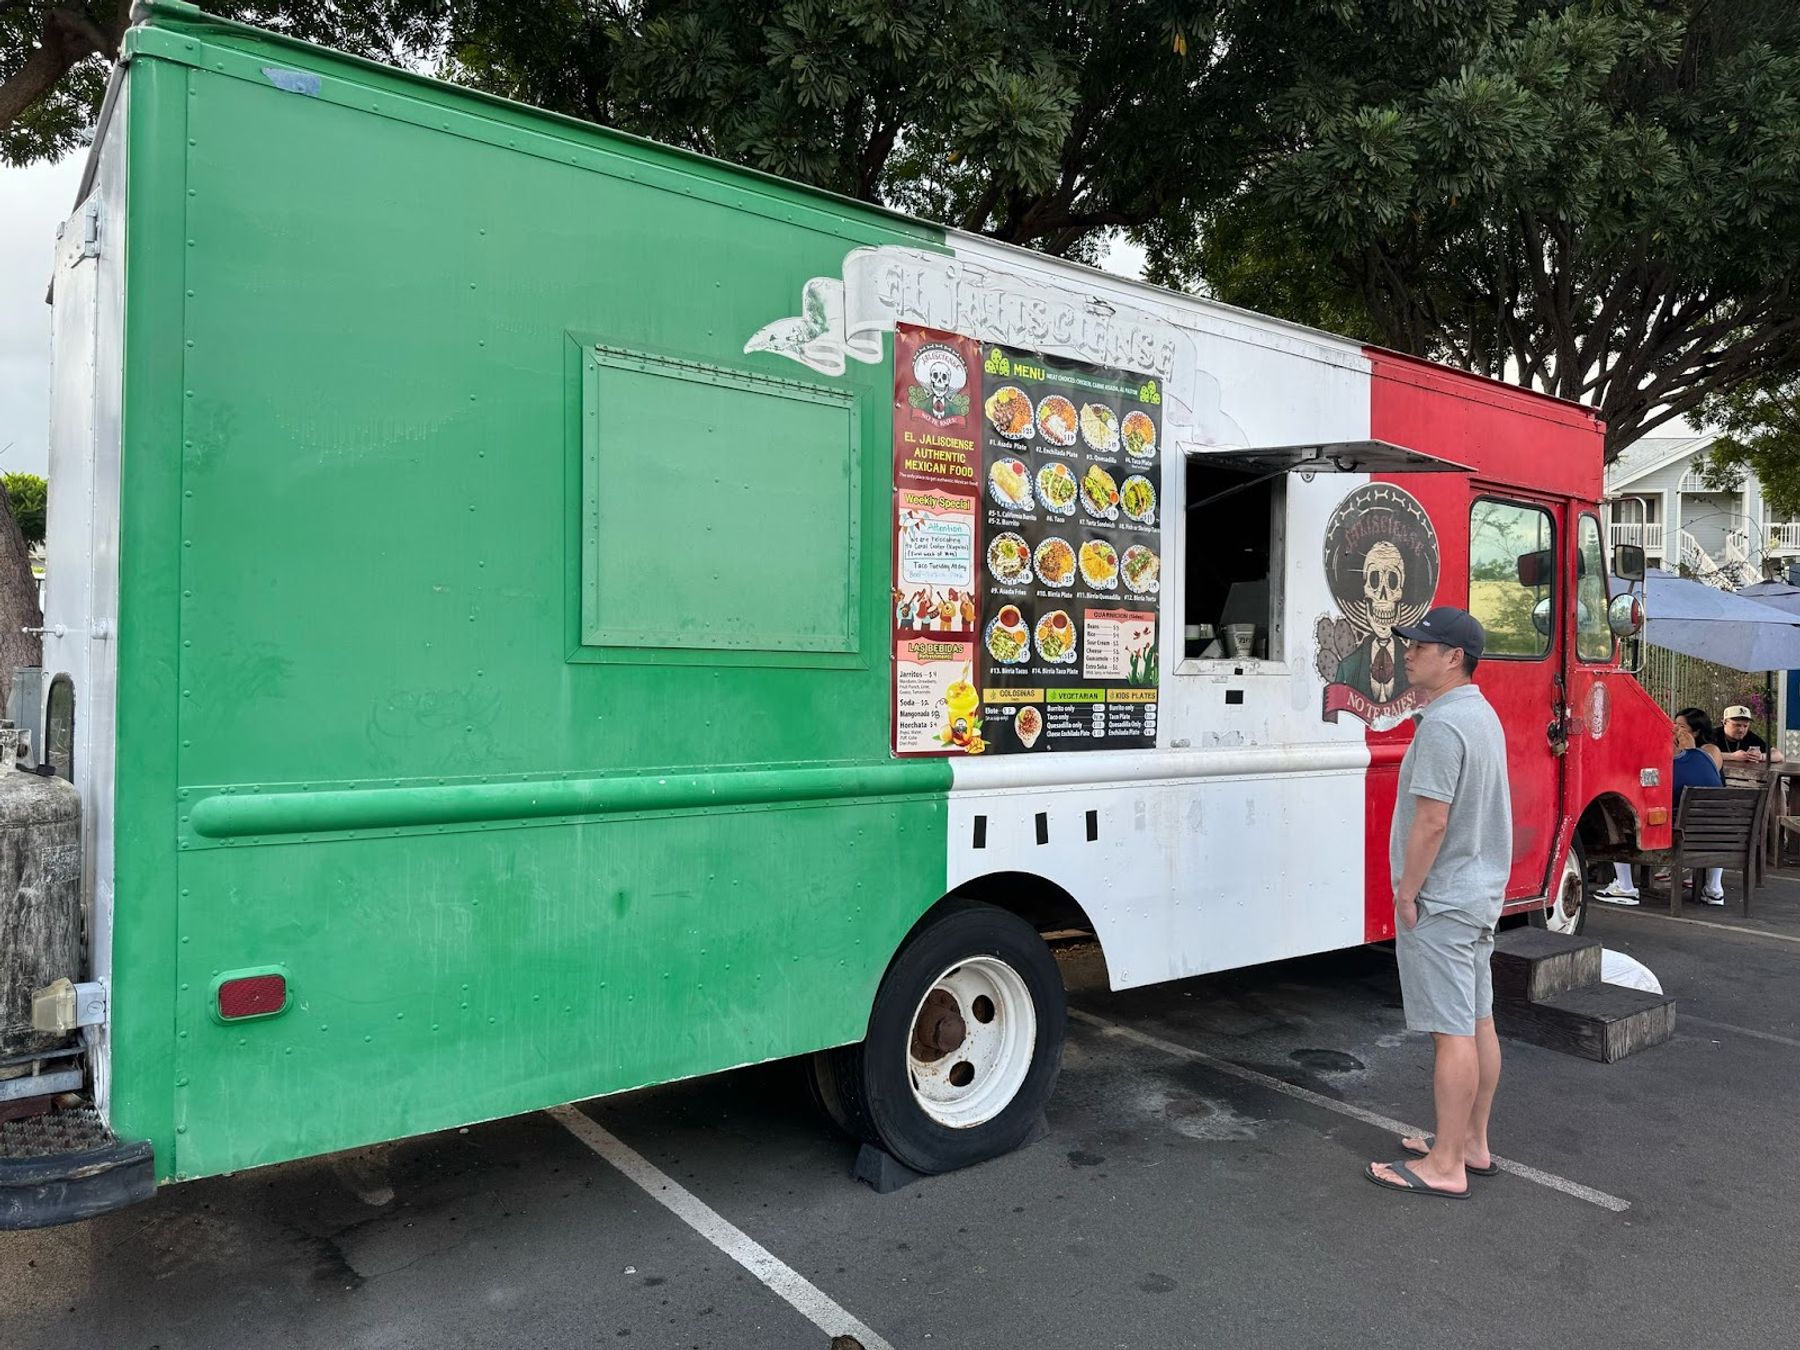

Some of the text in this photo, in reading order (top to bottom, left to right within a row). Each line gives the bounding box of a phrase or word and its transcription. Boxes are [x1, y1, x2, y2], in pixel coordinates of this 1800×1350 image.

[1013, 363, 1046, 381] MENU
[904, 431, 975, 451] EL JALISCIENSE
[1013, 442, 1027, 451] Plate
[913, 447, 966, 464] AUTHENTIC
[1066, 450, 1078, 458] Plate
[904, 459, 974, 477] MEXICAN FOOD
[904, 492, 971, 511] Weekly Special
[1002, 518, 1020, 527] Burrito
[928, 522, 962, 533] Attention
[913, 561, 929, 569] Taco
[929, 562, 950, 571] Tuesday
[1014, 588, 1027, 596] Fries
[1047, 590, 1060, 598] Birria
[908, 643, 964, 654] LAS BEBIDAS
[899, 670, 923, 678] Jarritos
[1015, 667, 1028, 675] Tacos
[1055, 667, 1066, 675] Taco
[1066, 667, 1078, 675] Plate
[1347, 691, 1365, 712] NO
[1047, 704, 1075, 713] Burrito only
[1125, 704, 1134, 712] only
[1059, 713, 1069, 721] only
[1072, 722, 1082, 730] only
